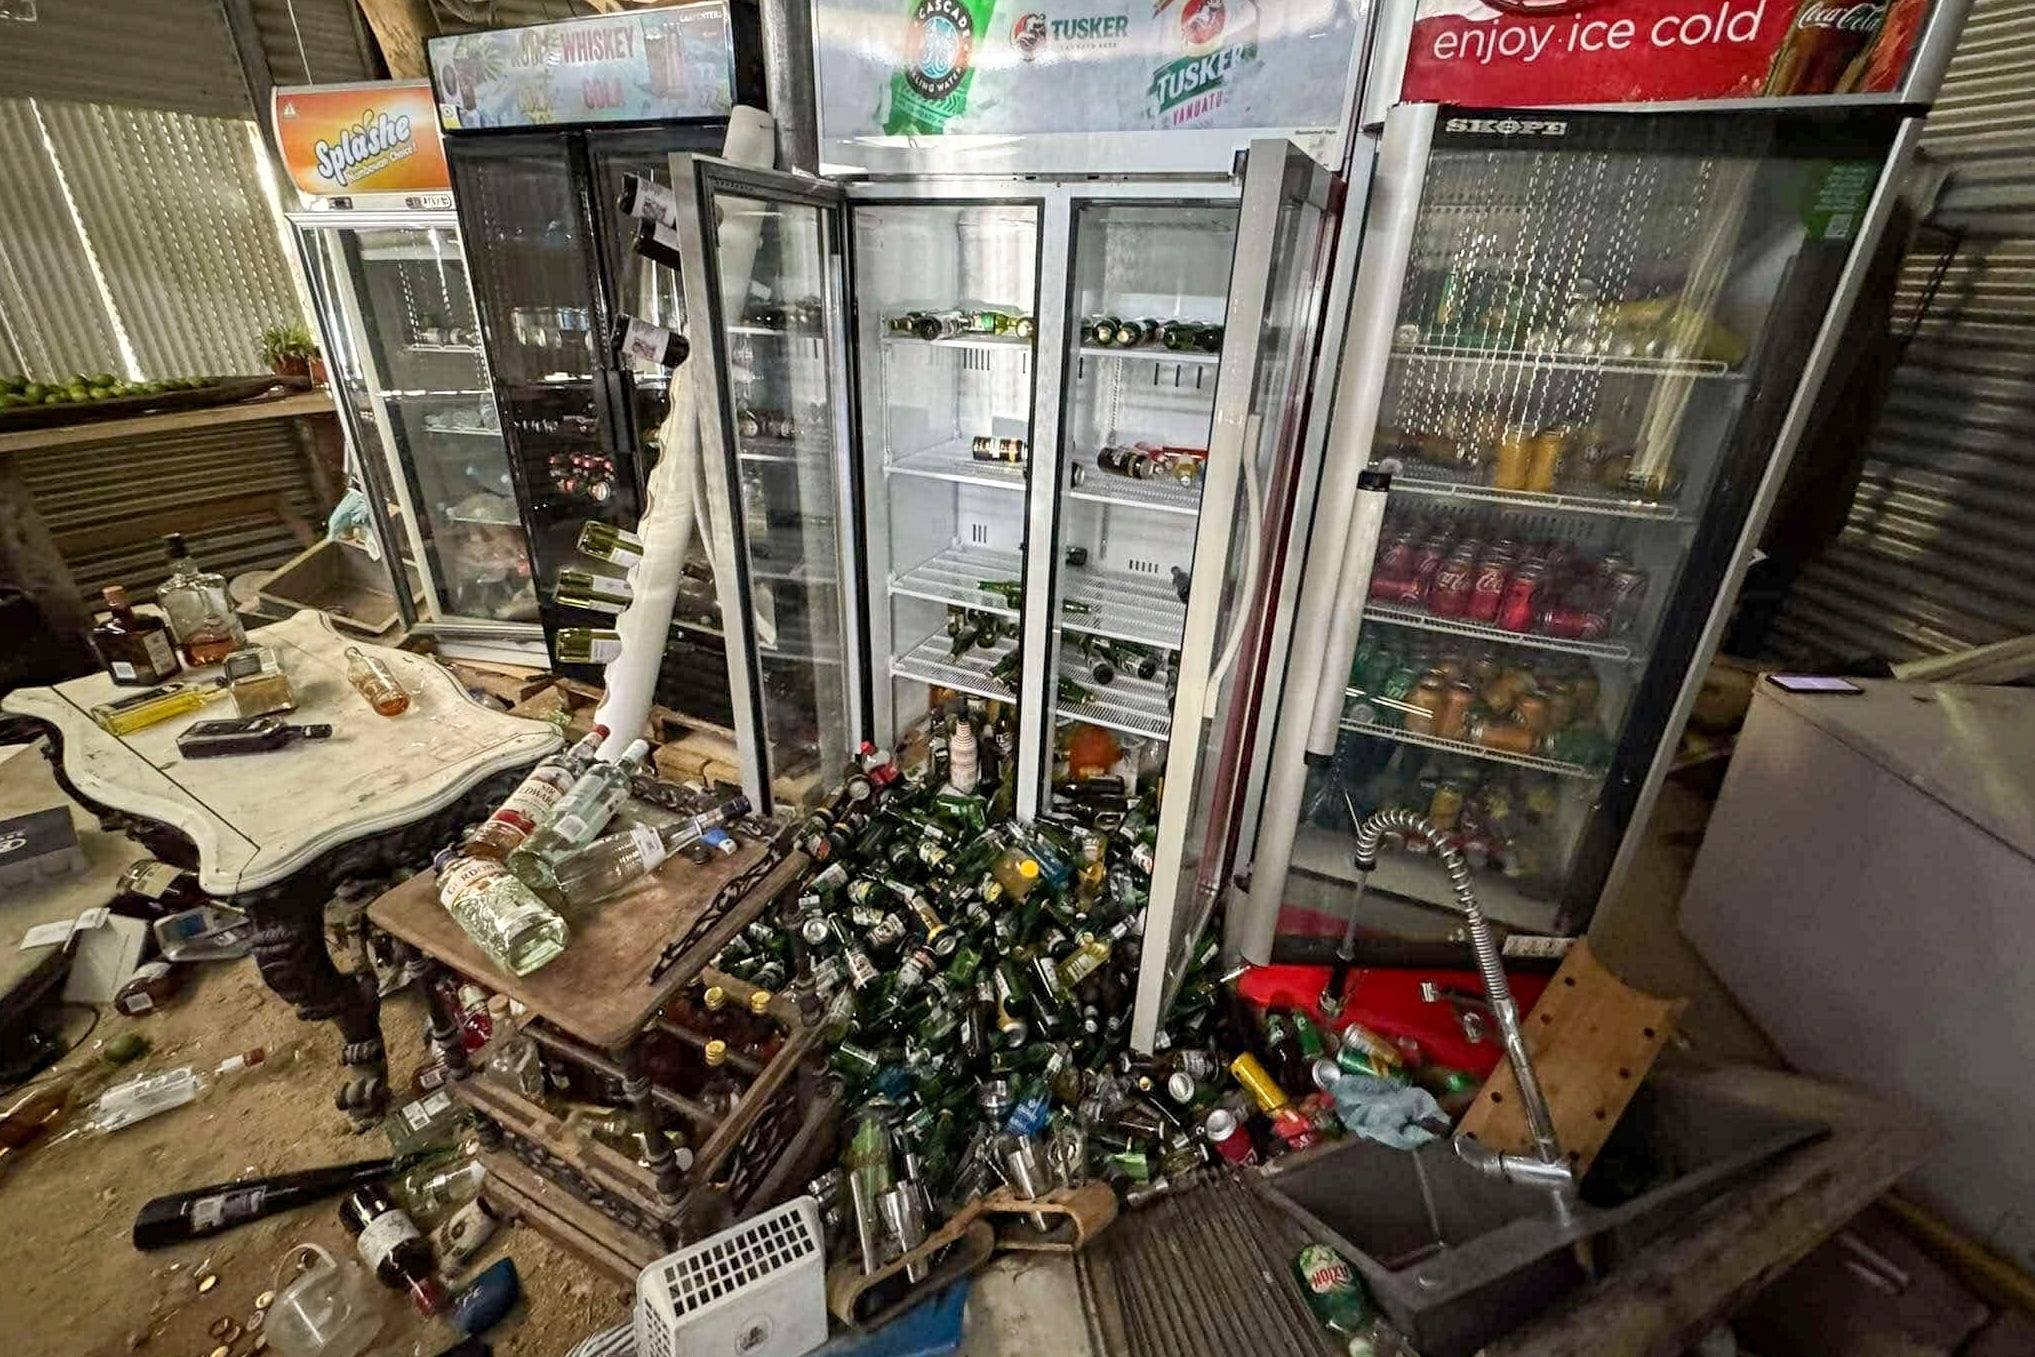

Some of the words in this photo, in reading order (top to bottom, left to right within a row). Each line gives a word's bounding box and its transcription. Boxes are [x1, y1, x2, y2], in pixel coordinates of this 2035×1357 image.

[919, 0, 971, 39] CASCADE
[1051, 15, 1128, 40] TUSKER
[1433, 19, 1555, 64] enjoy
[1567, 12, 1635, 52] ice
[1650, 0, 1766, 47] cold
[561, 25, 634, 63] WHISKEY
[1156, 43, 1244, 105] TUSKER
[1173, 90, 1223, 126] VANUATU
[1445, 117, 1567, 135] SKOPE
[315, 111, 411, 187] Splashe
